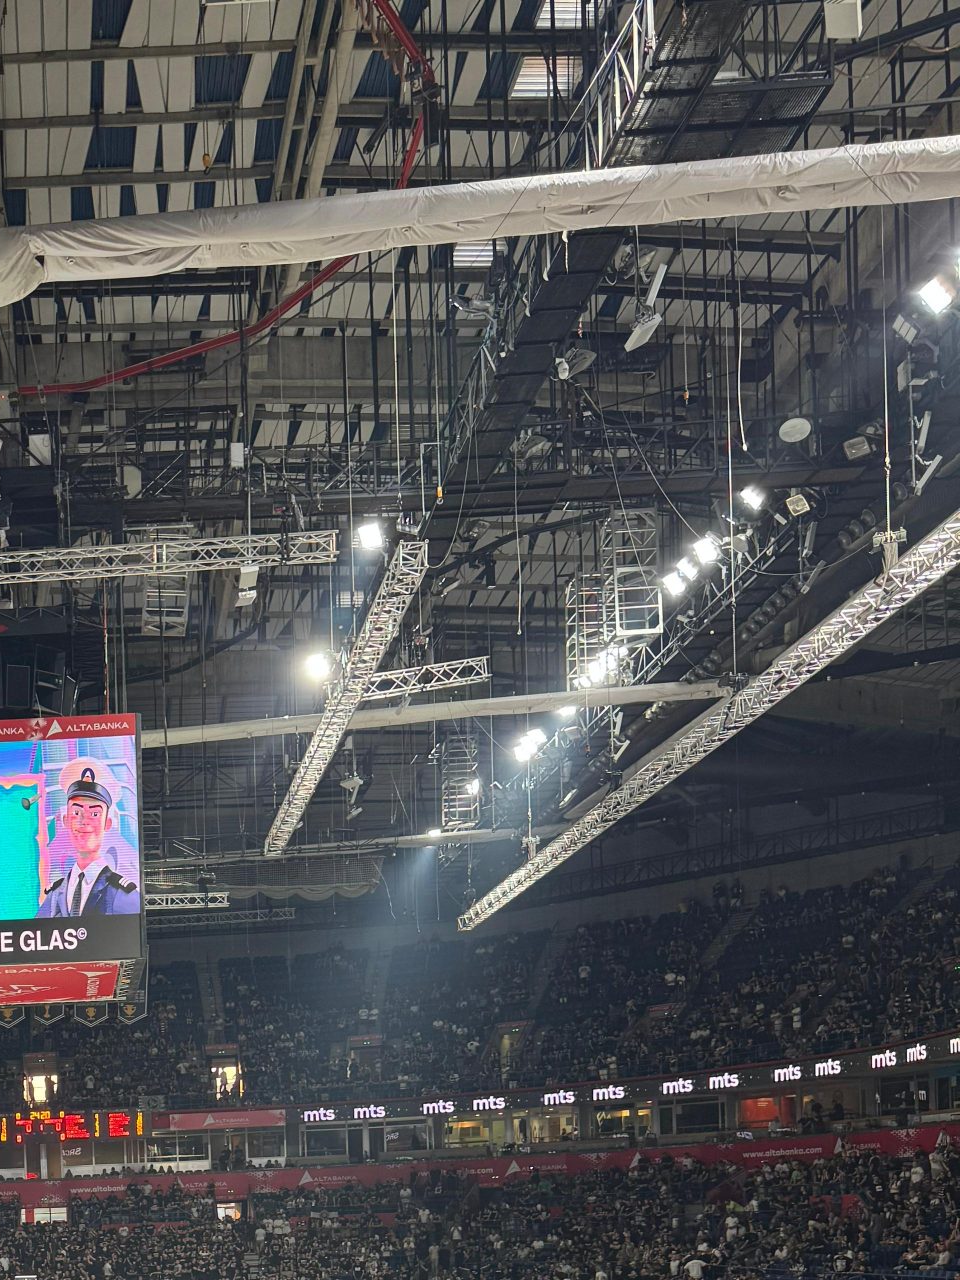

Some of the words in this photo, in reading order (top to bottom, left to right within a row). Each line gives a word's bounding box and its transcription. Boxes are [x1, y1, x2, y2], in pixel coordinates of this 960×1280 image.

[65, 721, 130, 733] ALTABANKA
[871, 1049, 897, 1069] mts
[906, 1042, 928, 1063] mts
[774, 1064, 802, 1083] mts
[814, 1058, 842, 1077] mts
[662, 1077, 694, 1095] mts
[708, 1072, 740, 1090] mts
[543, 1089, 576, 1106] mts
[592, 1084, 626, 1101] mts
[353, 1104, 386, 1119] mts
[422, 1099, 455, 1115] mts
[472, 1095, 506, 1111] mts
[303, 1107, 336, 1122] mts
